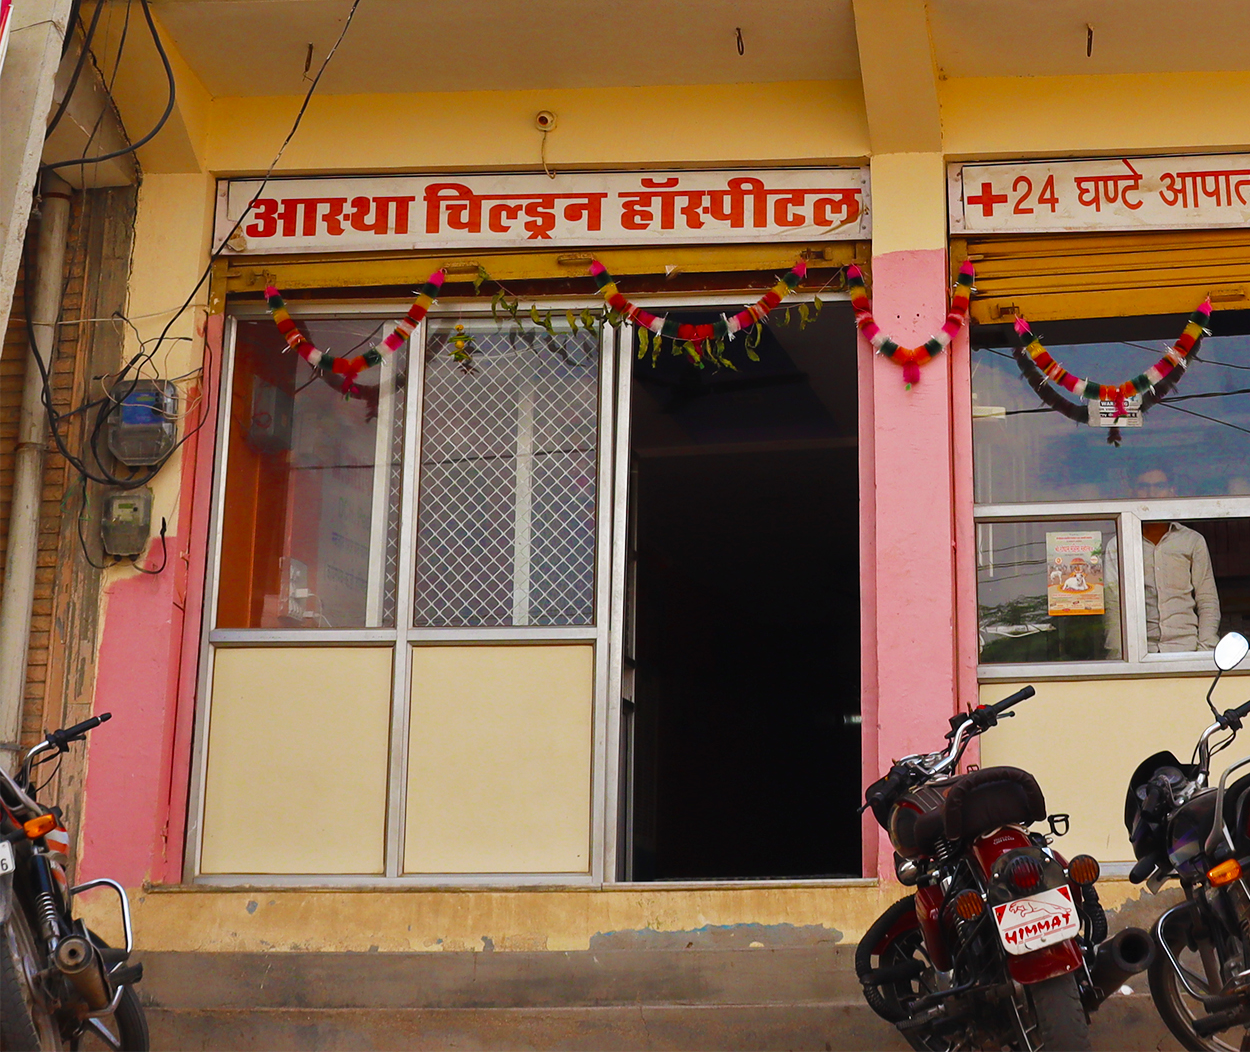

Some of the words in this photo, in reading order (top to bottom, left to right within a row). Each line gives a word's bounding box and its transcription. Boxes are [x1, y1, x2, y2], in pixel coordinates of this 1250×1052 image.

[246, 196, 415, 237] आस्था
[423, 183, 608, 239] चिल्ड्रन
[618, 177, 862, 230] हॉस्पीटल
[1013, 175, 1059, 214] 24
[1075, 159, 1143, 212] घण्टे
[1005, 912, 1071, 945] HIMMAT
